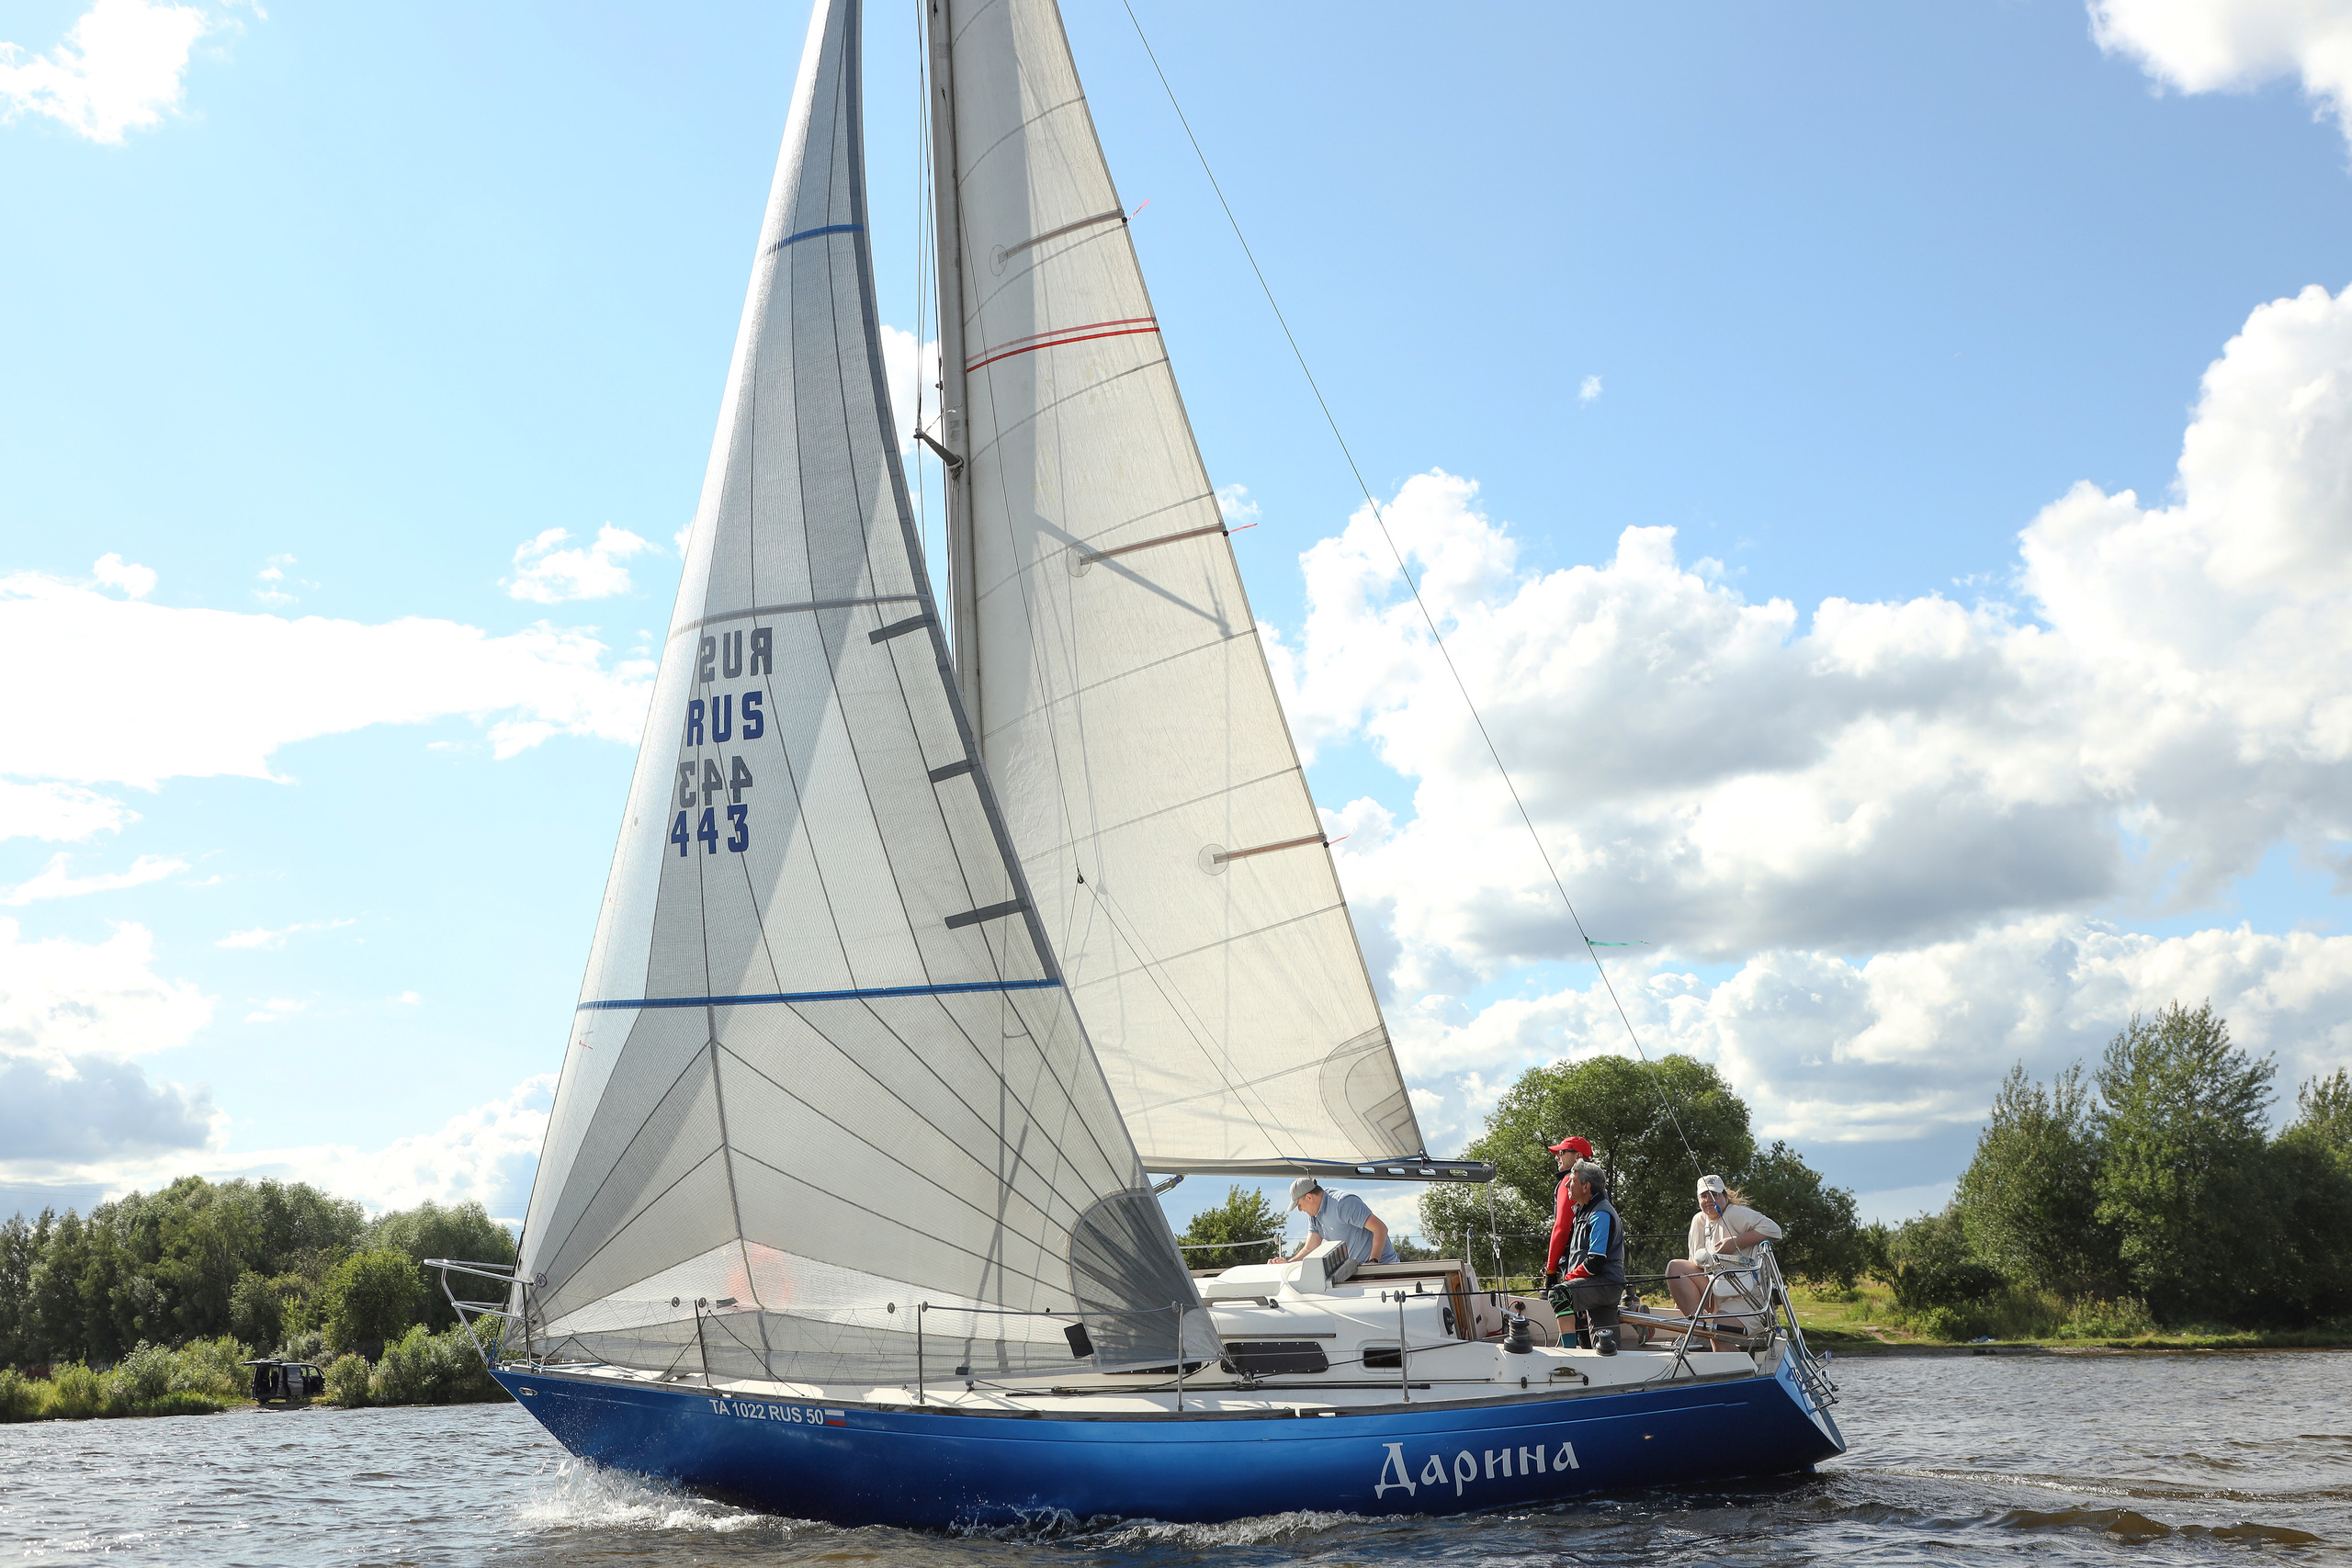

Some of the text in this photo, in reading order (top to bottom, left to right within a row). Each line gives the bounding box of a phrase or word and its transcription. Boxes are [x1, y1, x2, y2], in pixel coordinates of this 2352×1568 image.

[686, 691, 763, 747] RUS
[671, 804, 749, 857] 443
[708, 1399, 824, 1426] TA 1022 RUS 50
[1374, 1441, 1580, 1500] Дарина
